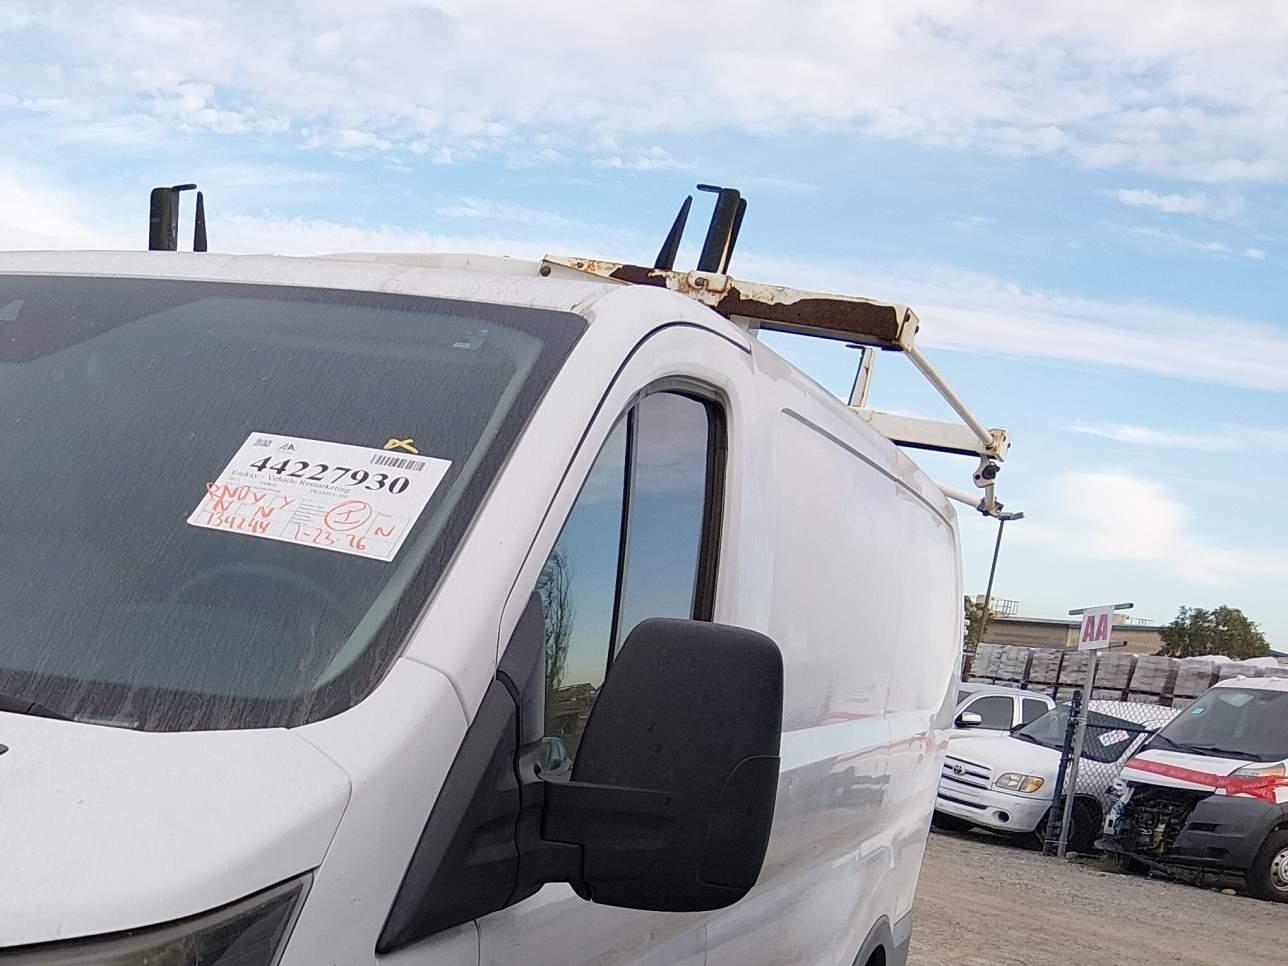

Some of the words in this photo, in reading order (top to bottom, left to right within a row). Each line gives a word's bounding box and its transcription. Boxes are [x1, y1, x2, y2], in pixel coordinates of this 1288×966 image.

[250, 456, 410, 494] 44227930
[268, 474, 295, 484] Vehicle
[299, 480, 351, 494] Remarketing
[1082, 614, 1108, 642] AA
